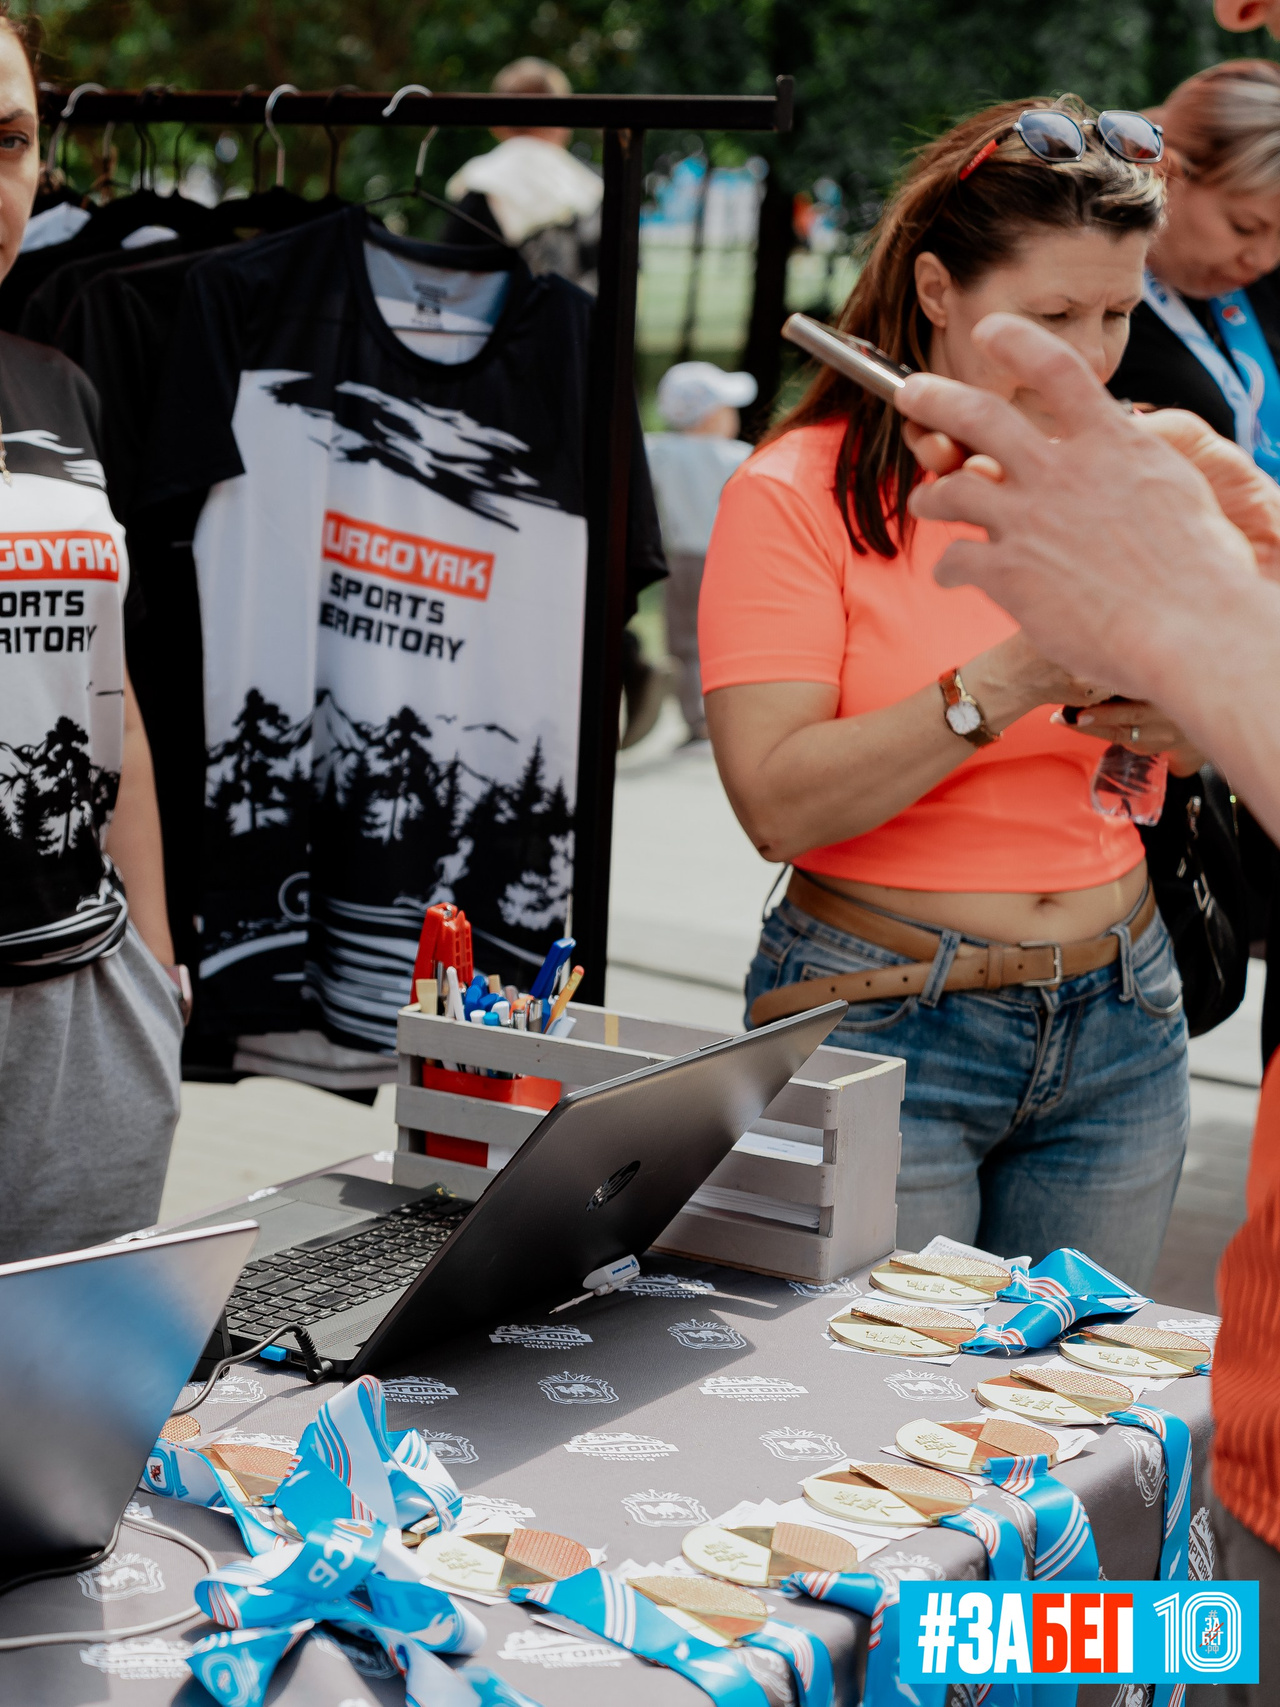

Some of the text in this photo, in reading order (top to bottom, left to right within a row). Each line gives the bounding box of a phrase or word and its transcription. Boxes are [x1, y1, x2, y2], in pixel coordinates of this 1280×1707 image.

[326, 520, 488, 593] URGOYAK
[330, 571, 445, 626] SPORTS
[319, 601, 465, 664] ERRITORY
[383, 1386, 452, 1394] РГОЯК
